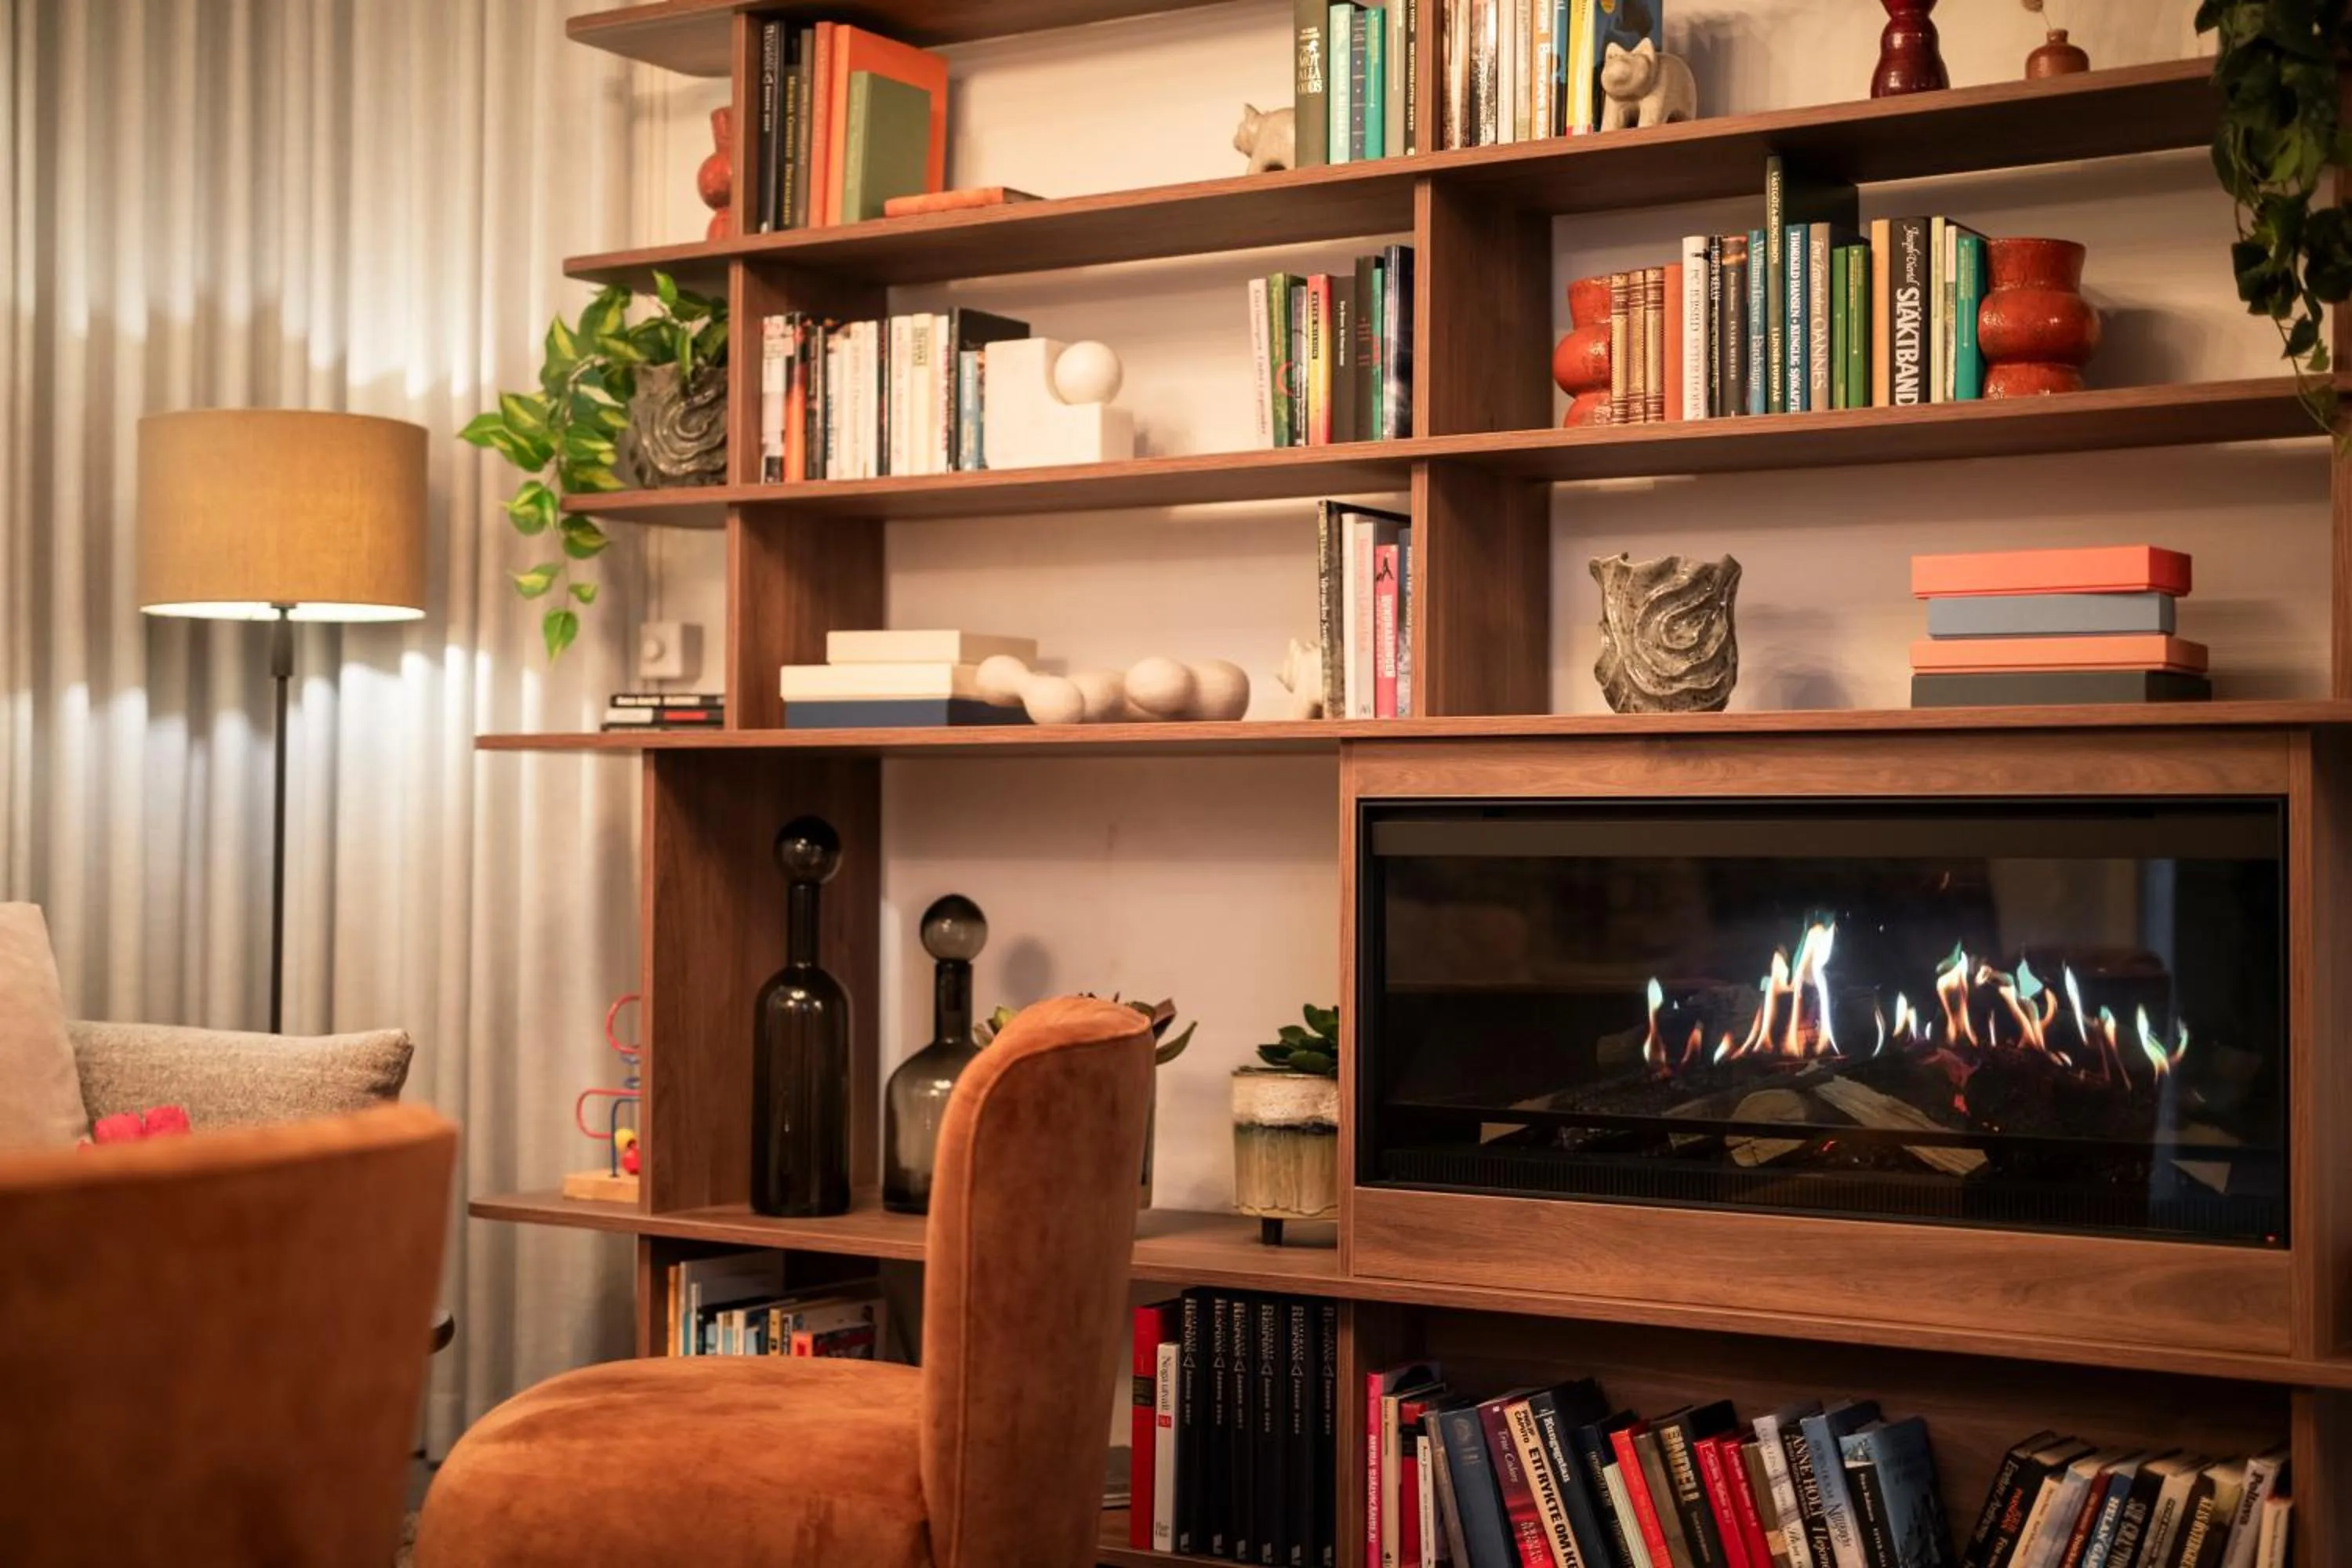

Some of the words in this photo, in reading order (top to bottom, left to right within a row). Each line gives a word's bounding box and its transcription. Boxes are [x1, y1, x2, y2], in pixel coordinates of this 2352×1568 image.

[1789, 230, 1801, 278] THORKILD
[1902, 225, 1920, 254] Joseph
[1789, 280, 1801, 318] HANSEN
[1790, 324, 1801, 366] KUNGLIG
[1812, 317, 1827, 390] OANNES
[1895, 287, 1922, 405] SLÄKTBAND
[1292, 1305, 1305, 1360] RESPONS
[1498, 1429, 1510, 1451] True
[1515, 1411, 1530, 1443] CAPUTO
[1544, 1417, 1570, 1483] Kungsgatan
[1529, 1447, 1544, 1472] ETT
[1538, 1472, 1562, 1523] RYKTE
[1554, 1523, 1572, 1549] OM
[1791, 1434, 1811, 1475] ANNE
[1803, 1478, 1823, 1516] HOLT
[2239, 1472, 2265, 1526] Poltava
